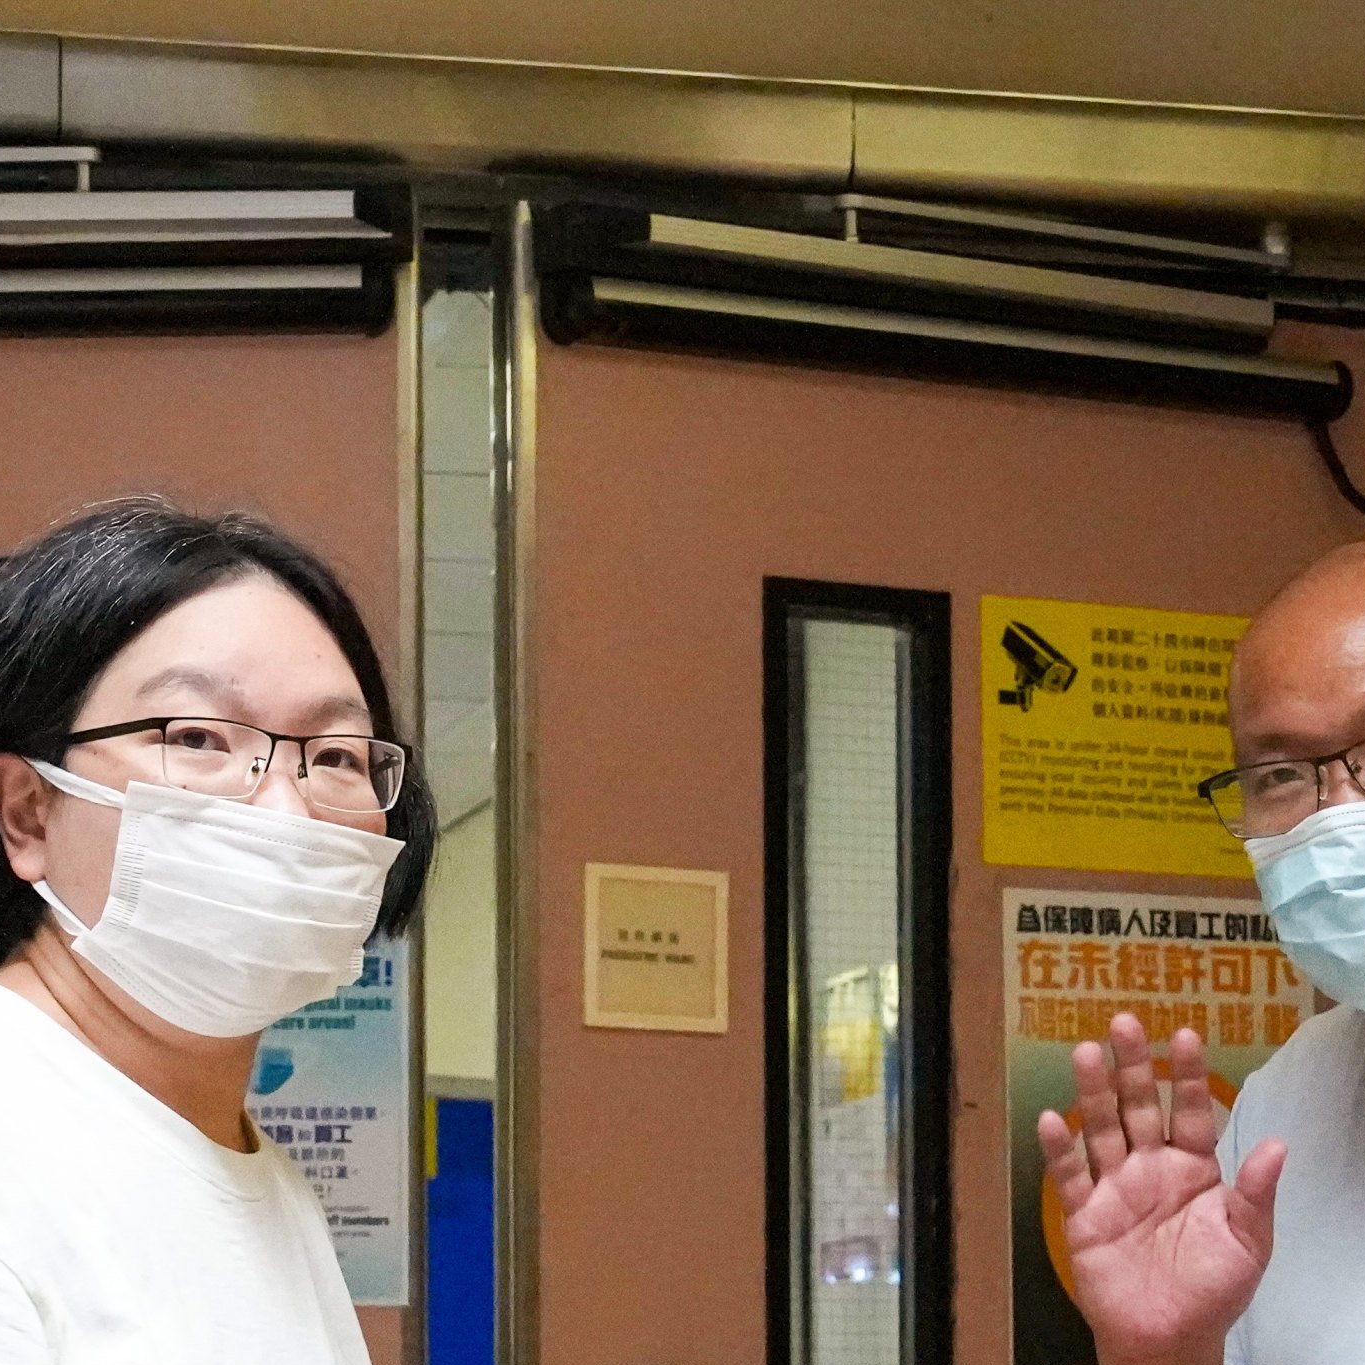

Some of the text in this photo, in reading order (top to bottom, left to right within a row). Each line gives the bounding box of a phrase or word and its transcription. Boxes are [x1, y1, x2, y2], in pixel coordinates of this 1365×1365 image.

[1019, 940, 1299, 996] 在未經許可下
